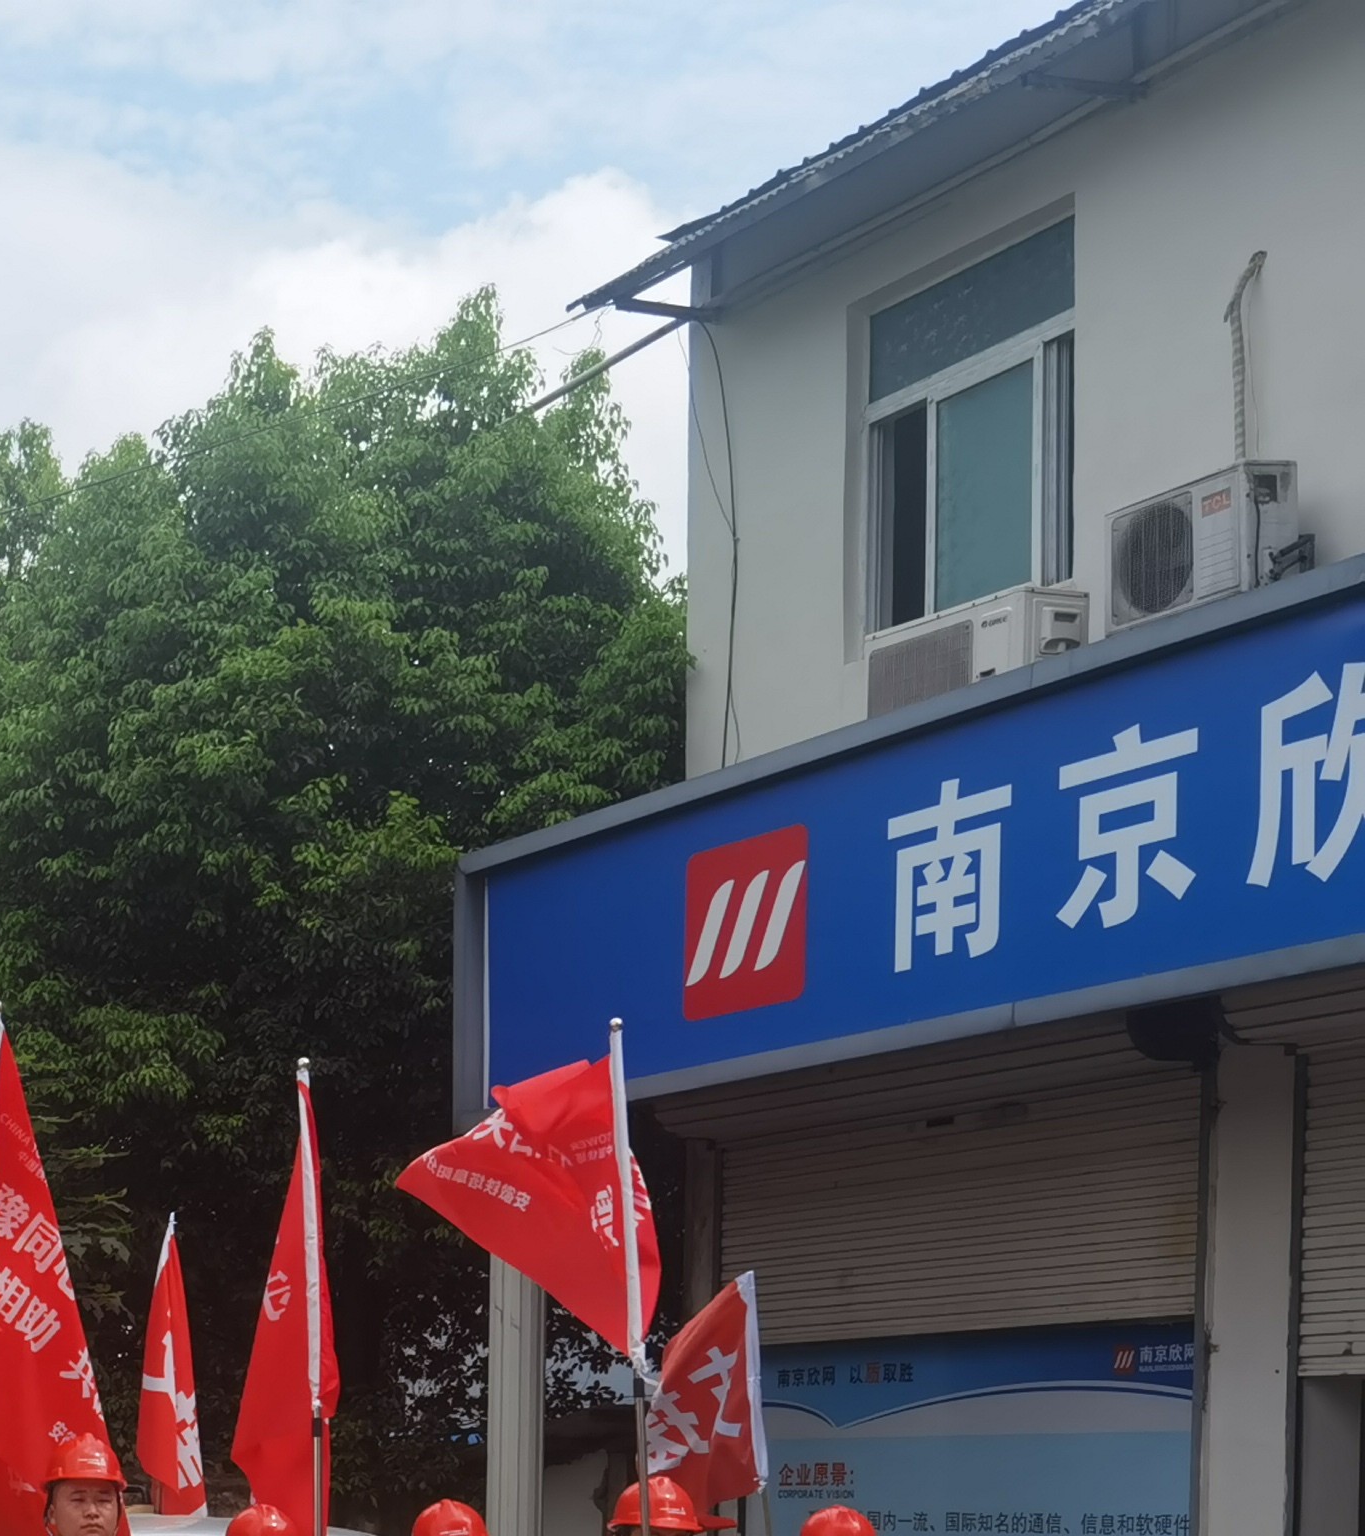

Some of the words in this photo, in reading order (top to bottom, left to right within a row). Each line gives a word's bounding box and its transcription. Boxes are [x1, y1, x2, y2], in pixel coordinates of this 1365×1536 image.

[1202, 491, 1231, 513] TCL
[1138, 1342, 1195, 1364] 南京欣网
[777, 1364, 837, 1389] 南京欣网
[849, 1361, 915, 1385] 以质取胜
[777, 1489, 824, 1500] CORPORATE
[825, 1488, 856, 1499] VISION
